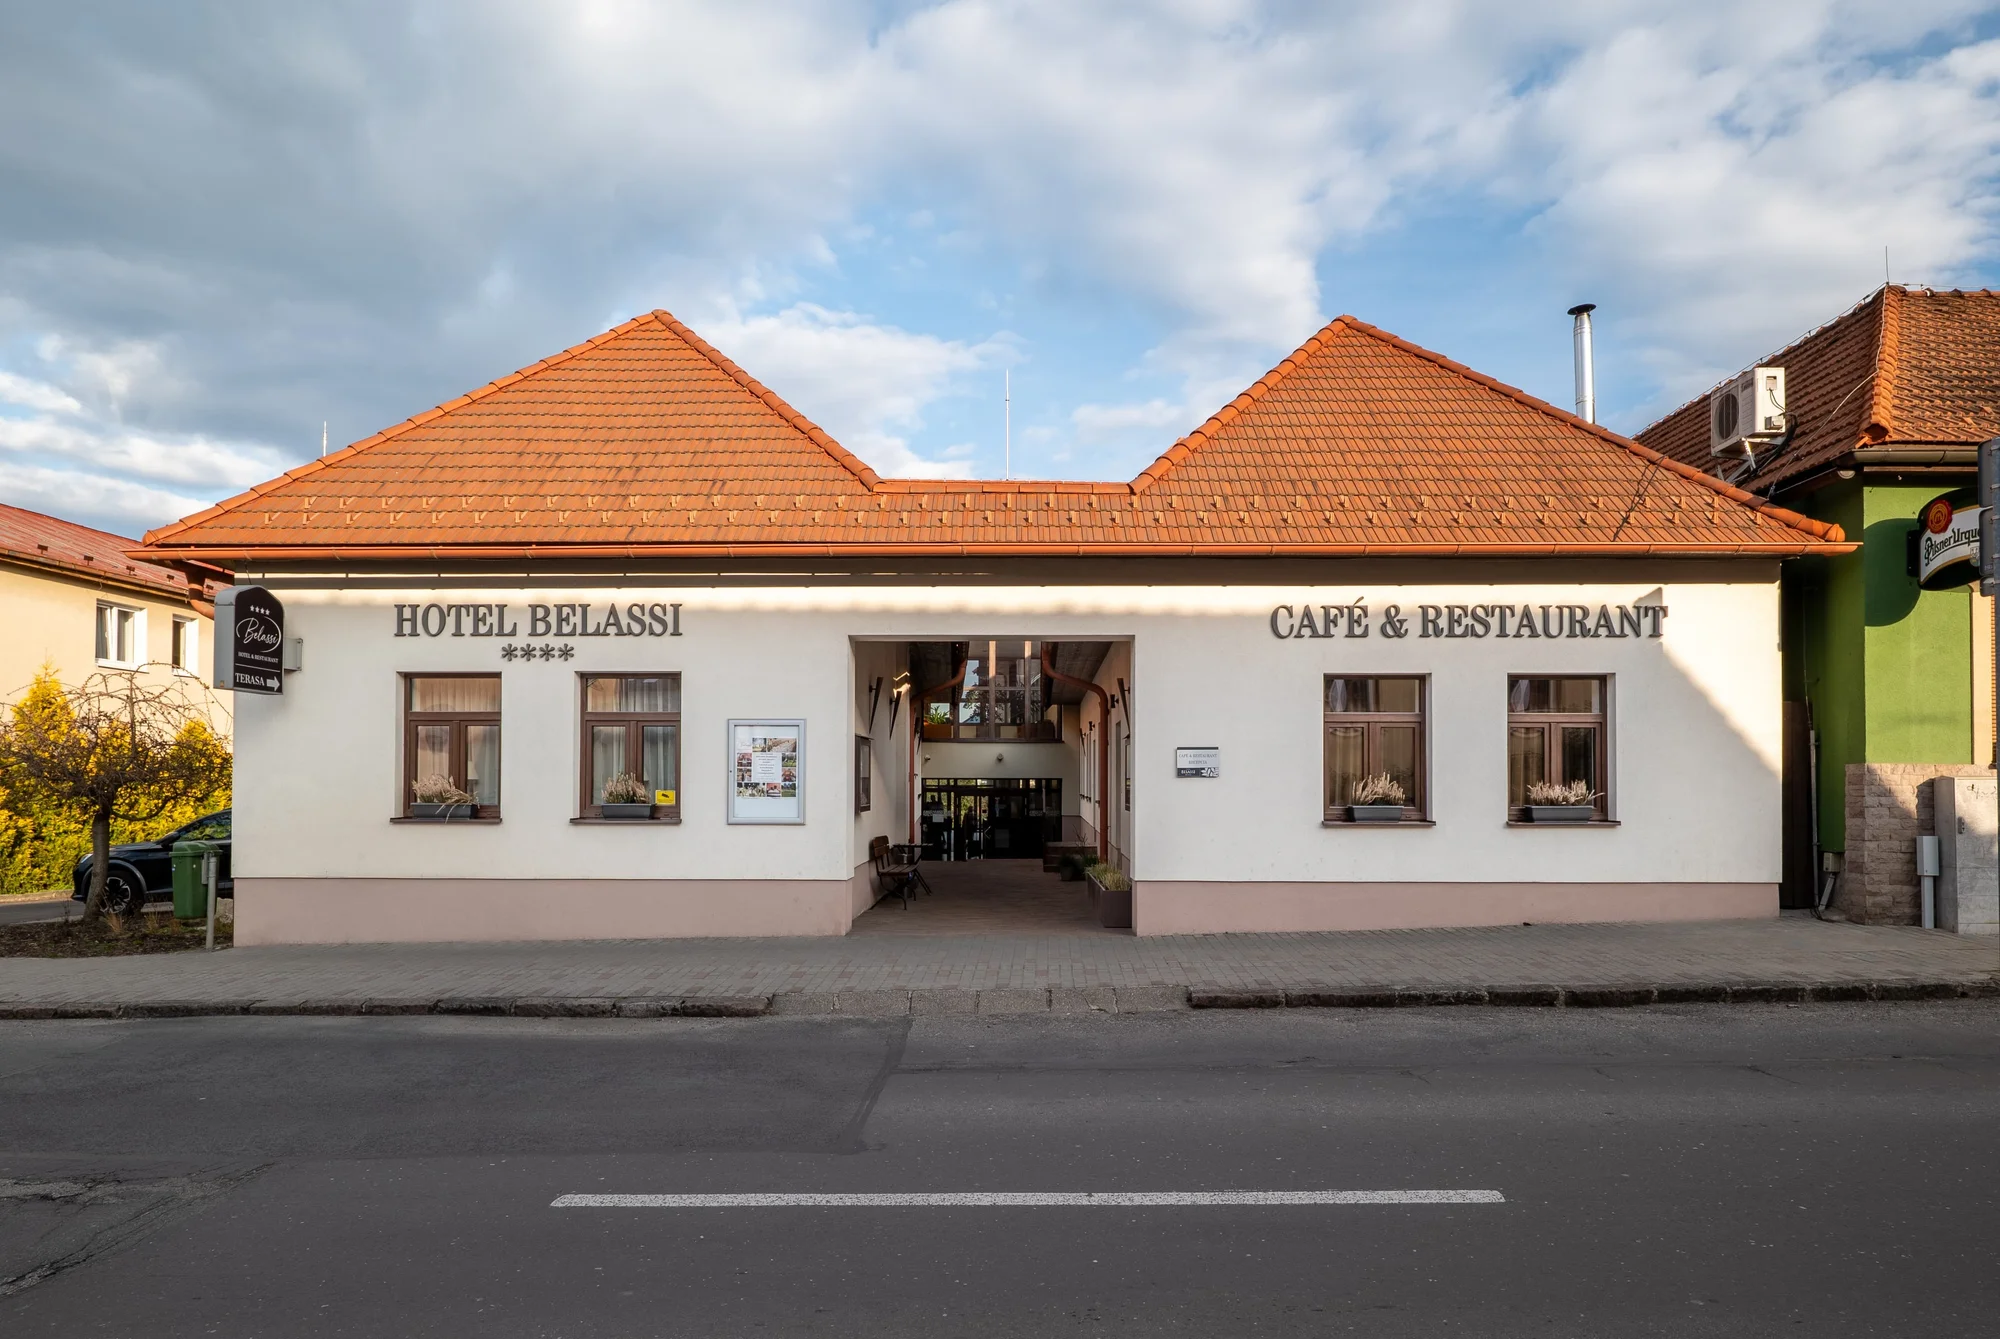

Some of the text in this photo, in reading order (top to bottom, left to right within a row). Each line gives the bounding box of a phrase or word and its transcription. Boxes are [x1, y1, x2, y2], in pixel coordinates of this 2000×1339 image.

[1924, 534, 1952, 567] Pilsner
[243, 617, 278, 644] Belassi
[393, 602, 684, 638] HOTEL BELASSI
[1270, 596, 1669, 639] CAFÉ & RESTAURANT
[238, 651, 251, 660] HOTEL
[254, 654, 279, 664] RESTAURANT
[235, 672, 265, 687] TERASA
